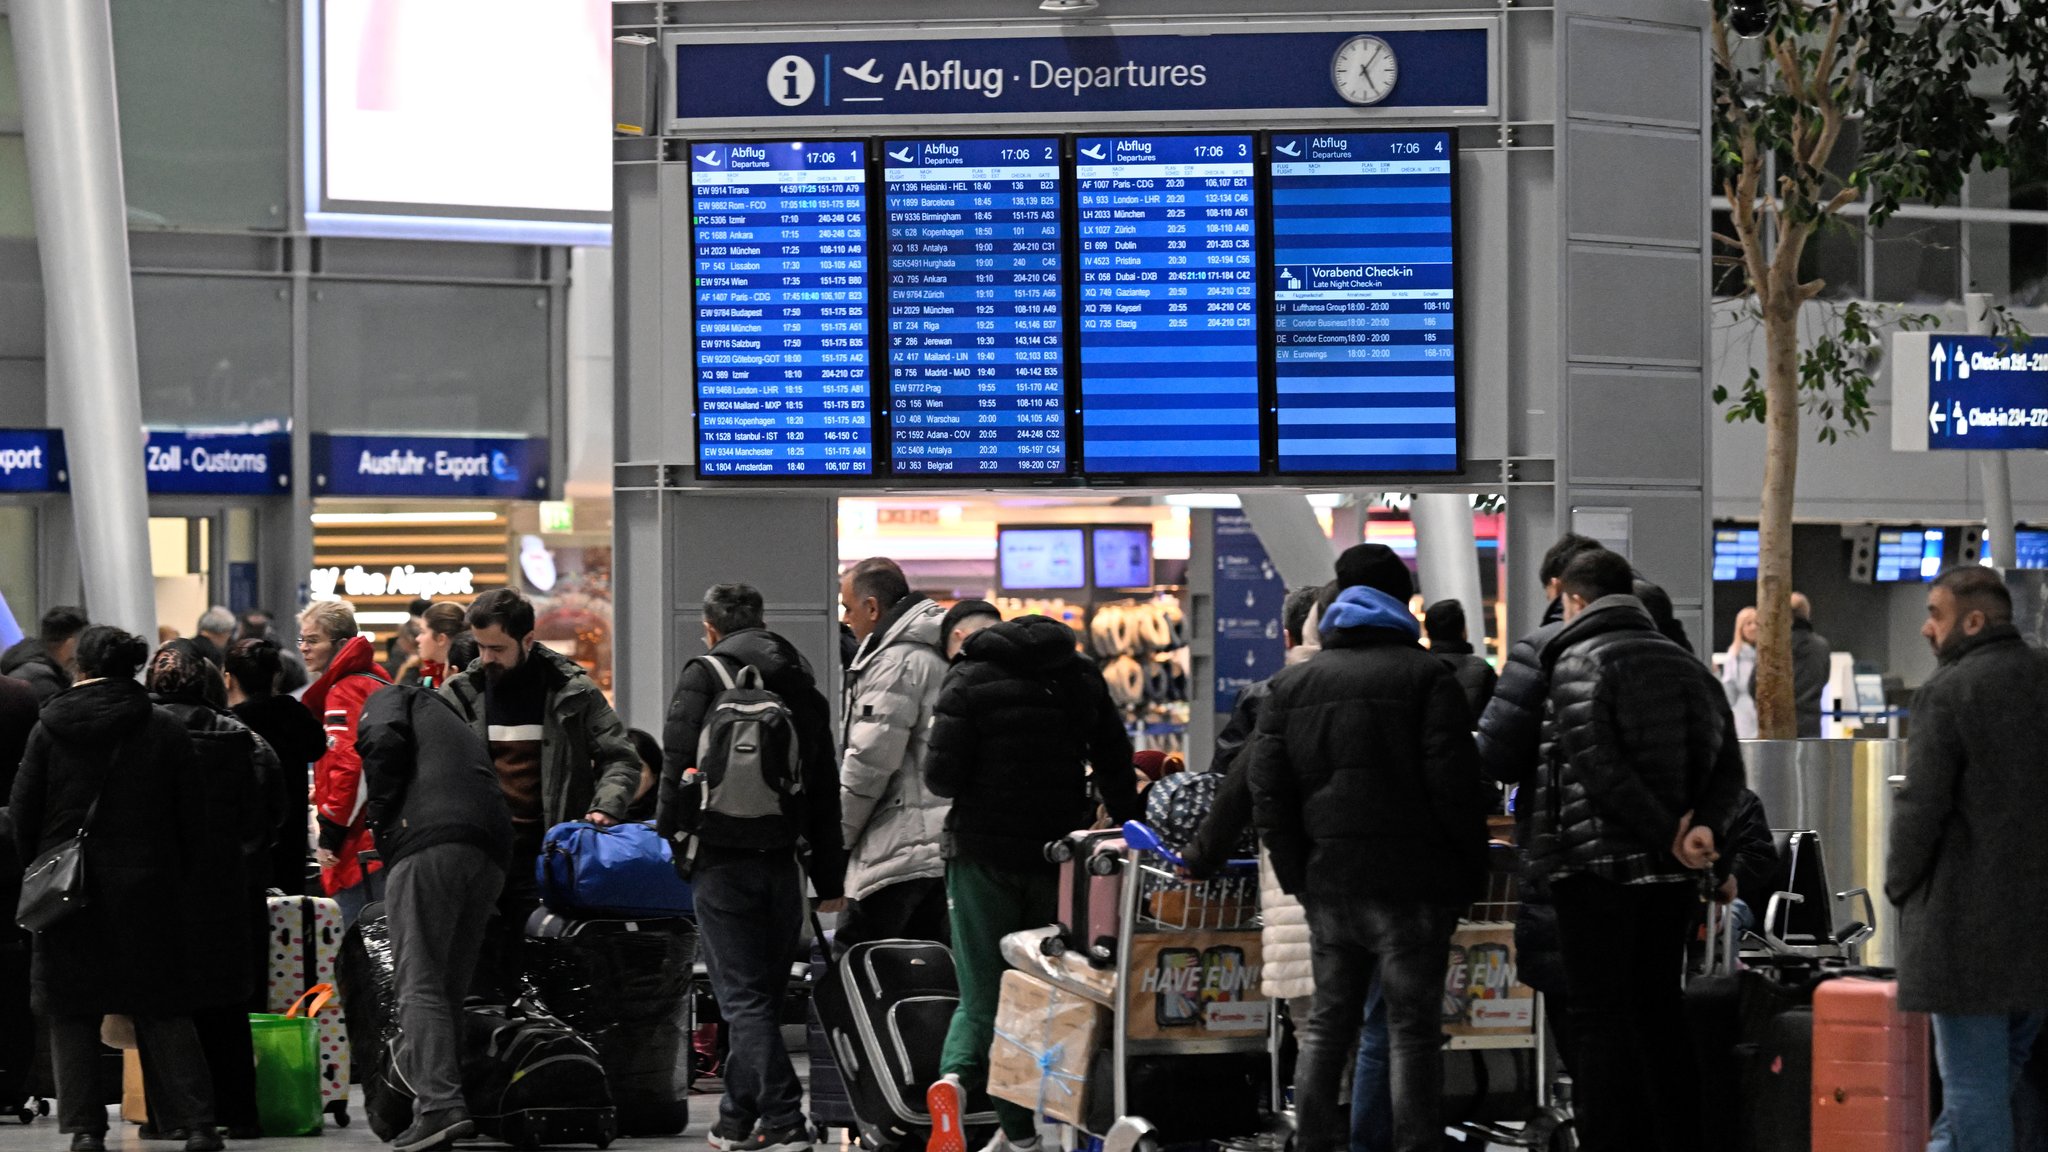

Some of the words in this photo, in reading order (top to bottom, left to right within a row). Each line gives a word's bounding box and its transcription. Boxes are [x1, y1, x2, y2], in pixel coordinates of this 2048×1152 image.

[895, 60, 1002, 97] Abflug
[1031, 60, 1206, 96] Departures
[1117, 141, 1151, 155] Abflug
[1313, 138, 1347, 150] Abflug
[1391, 143, 1419, 153] 17:06
[1435, 141, 1442, 152] 4
[731, 147, 765, 162] Abflug
[925, 144, 958, 159] Abflug
[1001, 149, 1029, 159] 17:06
[1045, 147, 1052, 159] 2
[1194, 146, 1223, 156] 17:06
[1239, 144, 1246, 156] 3
[1313, 151, 1351, 159] Departures
[807, 153, 835, 163] 17:06
[851, 151, 856, 162] 1
[925, 157, 963, 165] Departures
[1118, 154, 1156, 162] Departures
[732, 160, 769, 168] Departures
[902, 183, 917, 191] 1396
[921, 183, 947, 191] Helsinki
[974, 182, 991, 190] 18:40
[1041, 181, 1053, 189] B23
[1082, 180, 1091, 189] AF
[1094, 180, 1109, 189] 1007
[1113, 180, 1130, 188] Paris
[1137, 180, 1154, 188] CDG
[1166, 179, 1184, 188] 20:20
[1234, 178, 1246, 187] B21
[698, 187, 709, 195] EW
[711, 187, 727, 195] 9914
[728, 186, 749, 195] Tirana
[780, 186, 797, 194] 14:50
[798, 186, 816, 194] 17:25
[818, 185, 843, 194] 151-170
[846, 185, 858, 194] A79
[892, 213, 903, 221] EW
[922, 213, 961, 222] Birmingham
[975, 212, 992, 220] 18:45
[905, 228, 917, 236] 628
[922, 228, 964, 237] Kopenhagen
[1115, 241, 1136, 249] Dublin
[1207, 240, 1233, 248] 201-203
[1236, 240, 1249, 248] C36
[711, 247, 726, 255] 2023
[782, 246, 799, 254] 17:25
[848, 245, 861, 253] A49
[923, 259, 955, 268] Hurghada
[1014, 258, 1025, 266] 240
[1042, 258, 1056, 266] C45
[1085, 273, 1095, 281] EK
[1098, 273, 1111, 281] 058
[1142, 272, 1157, 280] DXB
[1169, 272, 1187, 280] 20:45
[1236, 271, 1250, 279] C42
[1312, 267, 1362, 277] Vorabend
[1365, 266, 1412, 276] Check-in
[701, 278, 713, 286] EW
[714, 278, 729, 286] 9754
[783, 277, 800, 285] 17:35
[1330, 281, 1349, 289] Night
[1326, 303, 1346, 312] Group
[1347, 303, 1365, 311] 18:00
[1318, 335, 1347, 343] Economy
[1348, 334, 1365, 342] 18:00
[1371, 334, 1389, 342] 20:00
[1294, 351, 1327, 359] Eurowings
[1372, 349, 1390, 357] 20:00
[895, 384, 907, 392] EW
[908, 384, 924, 392] 9772
[926, 384, 941, 393] Prag
[1016, 383, 1042, 391] 151-170
[1045, 383, 1058, 391] A42
[1969, 408, 2008, 426] Check-in
[767, 432, 778, 440] IST
[787, 432, 804, 440] 18:20
[0, 447, 41, 474] xport
[148, 446, 181, 471] Zoll
[191, 447, 266, 472] Customs
[359, 450, 426, 474] Ausfuhr
[435, 451, 488, 480] Export
[705, 463, 714, 471] KL
[716, 463, 731, 471] 1804
[735, 463, 772, 471] Amsterdam
[853, 462, 865, 470] B51
[910, 461, 921, 469] 363
[928, 462, 952, 471] Belgrad
[980, 461, 997, 469] 20:20
[1019, 461, 1044, 469] 198-200
[343, 565, 386, 595] the
[387, 565, 473, 600] Airport
[1141, 966, 1203, 992] HAVE
[1206, 966, 1259, 990] FUN!
